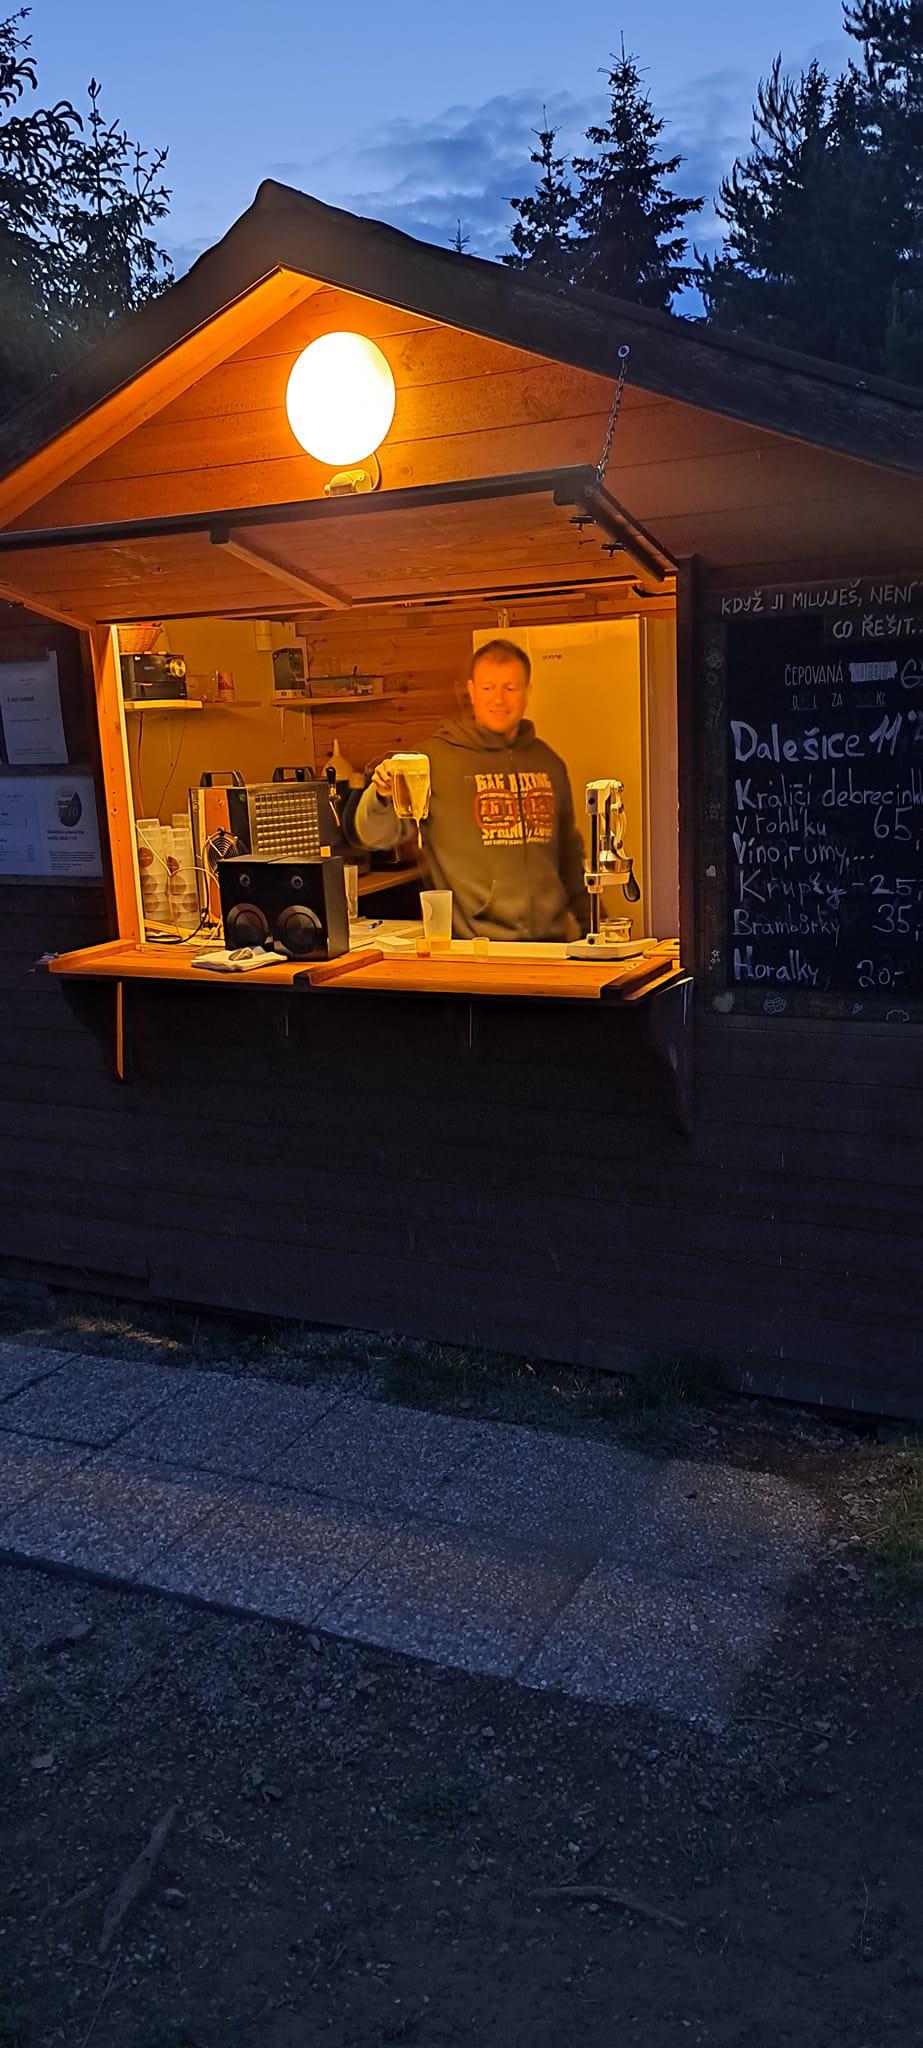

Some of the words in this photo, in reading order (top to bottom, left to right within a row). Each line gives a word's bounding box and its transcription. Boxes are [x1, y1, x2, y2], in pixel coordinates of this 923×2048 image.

[720, 590, 765, 617] KDYŽ
[770, 593, 784, 611] JI
[832, 620, 853, 640] CO
[784, 660, 844, 687] ČEPOVANÁ
[730, 719, 866, 763] Dalešice
